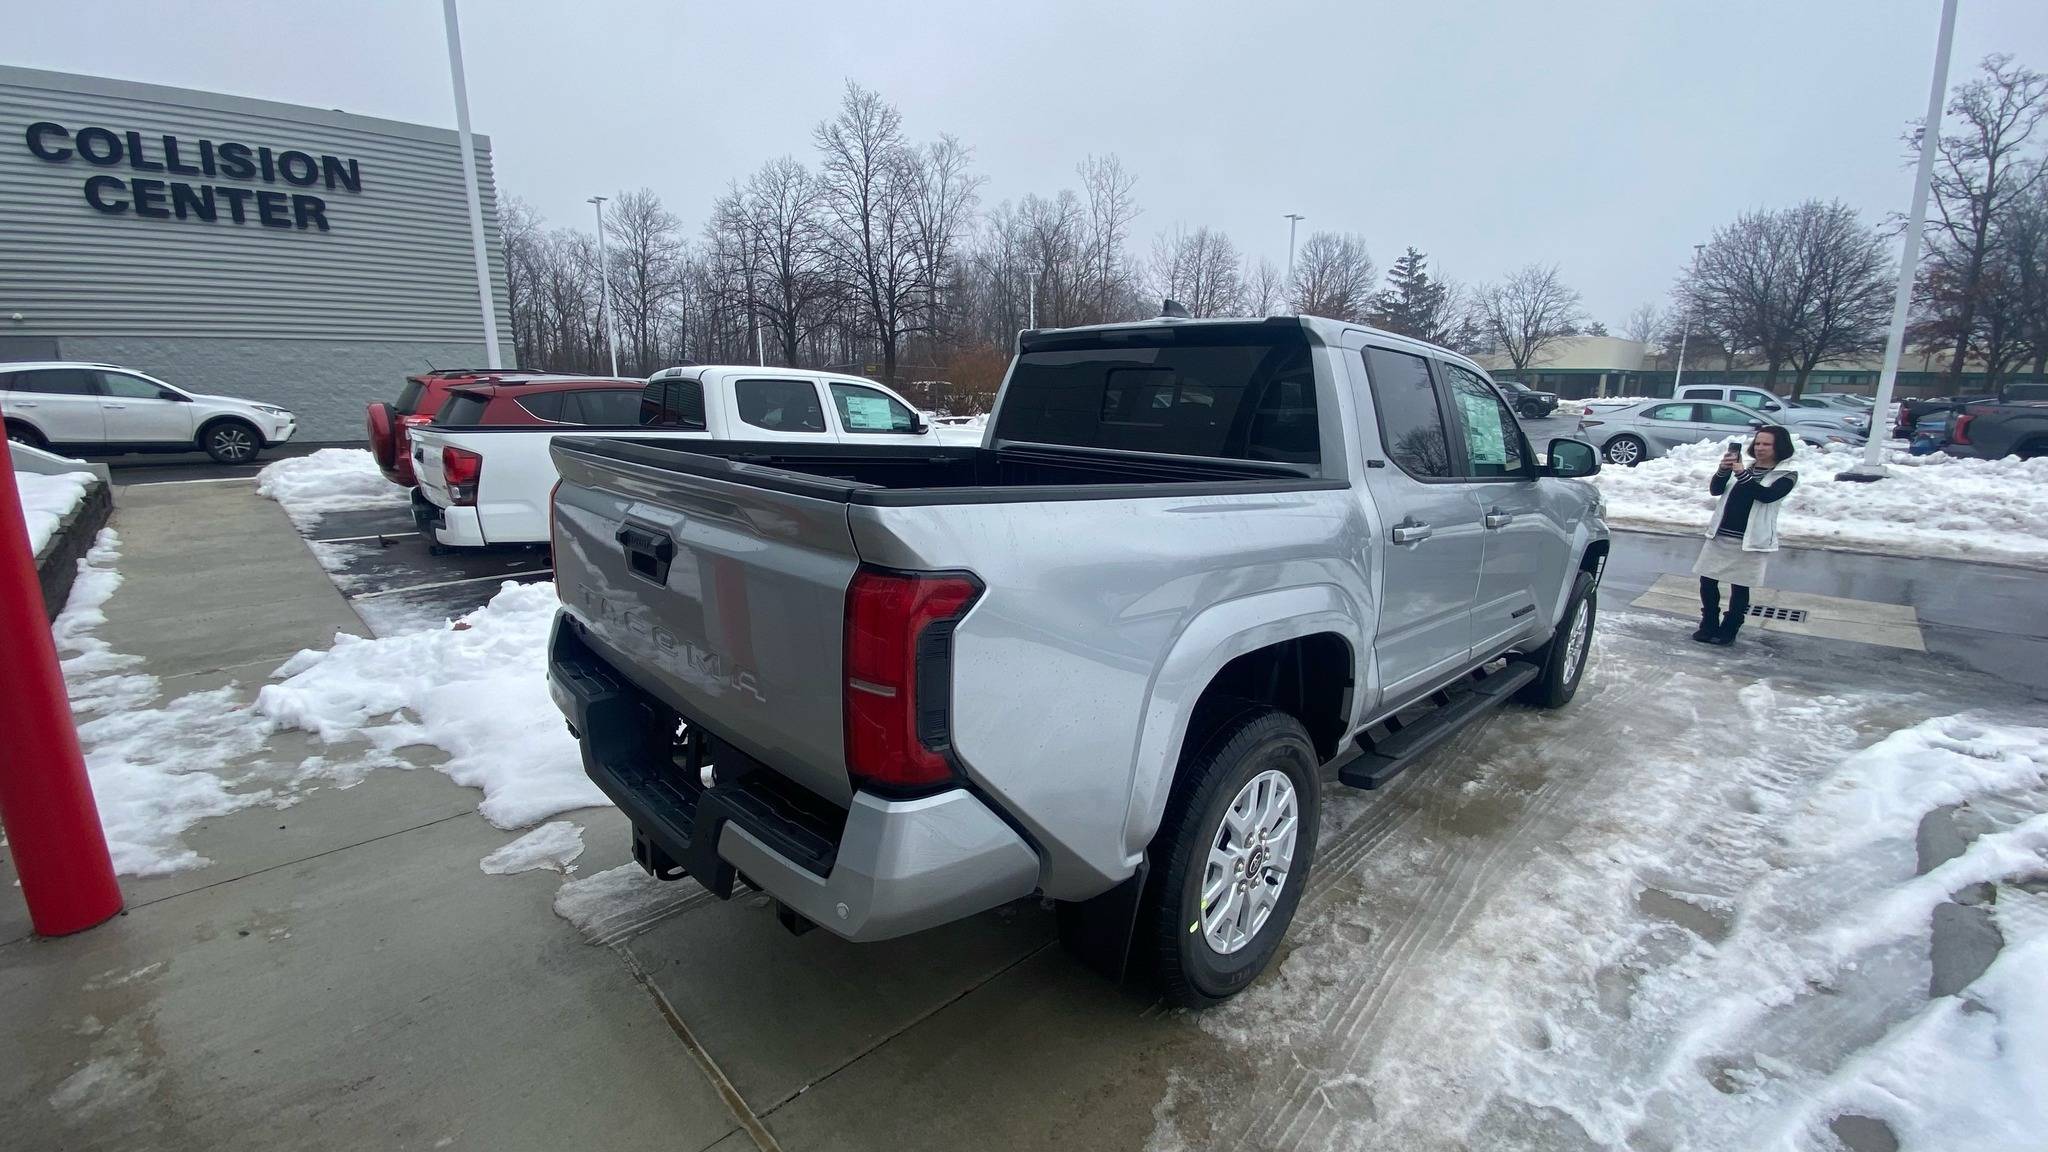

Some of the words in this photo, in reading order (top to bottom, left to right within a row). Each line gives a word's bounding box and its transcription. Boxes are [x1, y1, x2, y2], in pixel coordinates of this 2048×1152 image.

[25, 121, 362, 193] COLLISION
[83, 174, 330, 231] CENTER
[577, 582, 767, 703] TACOMA
